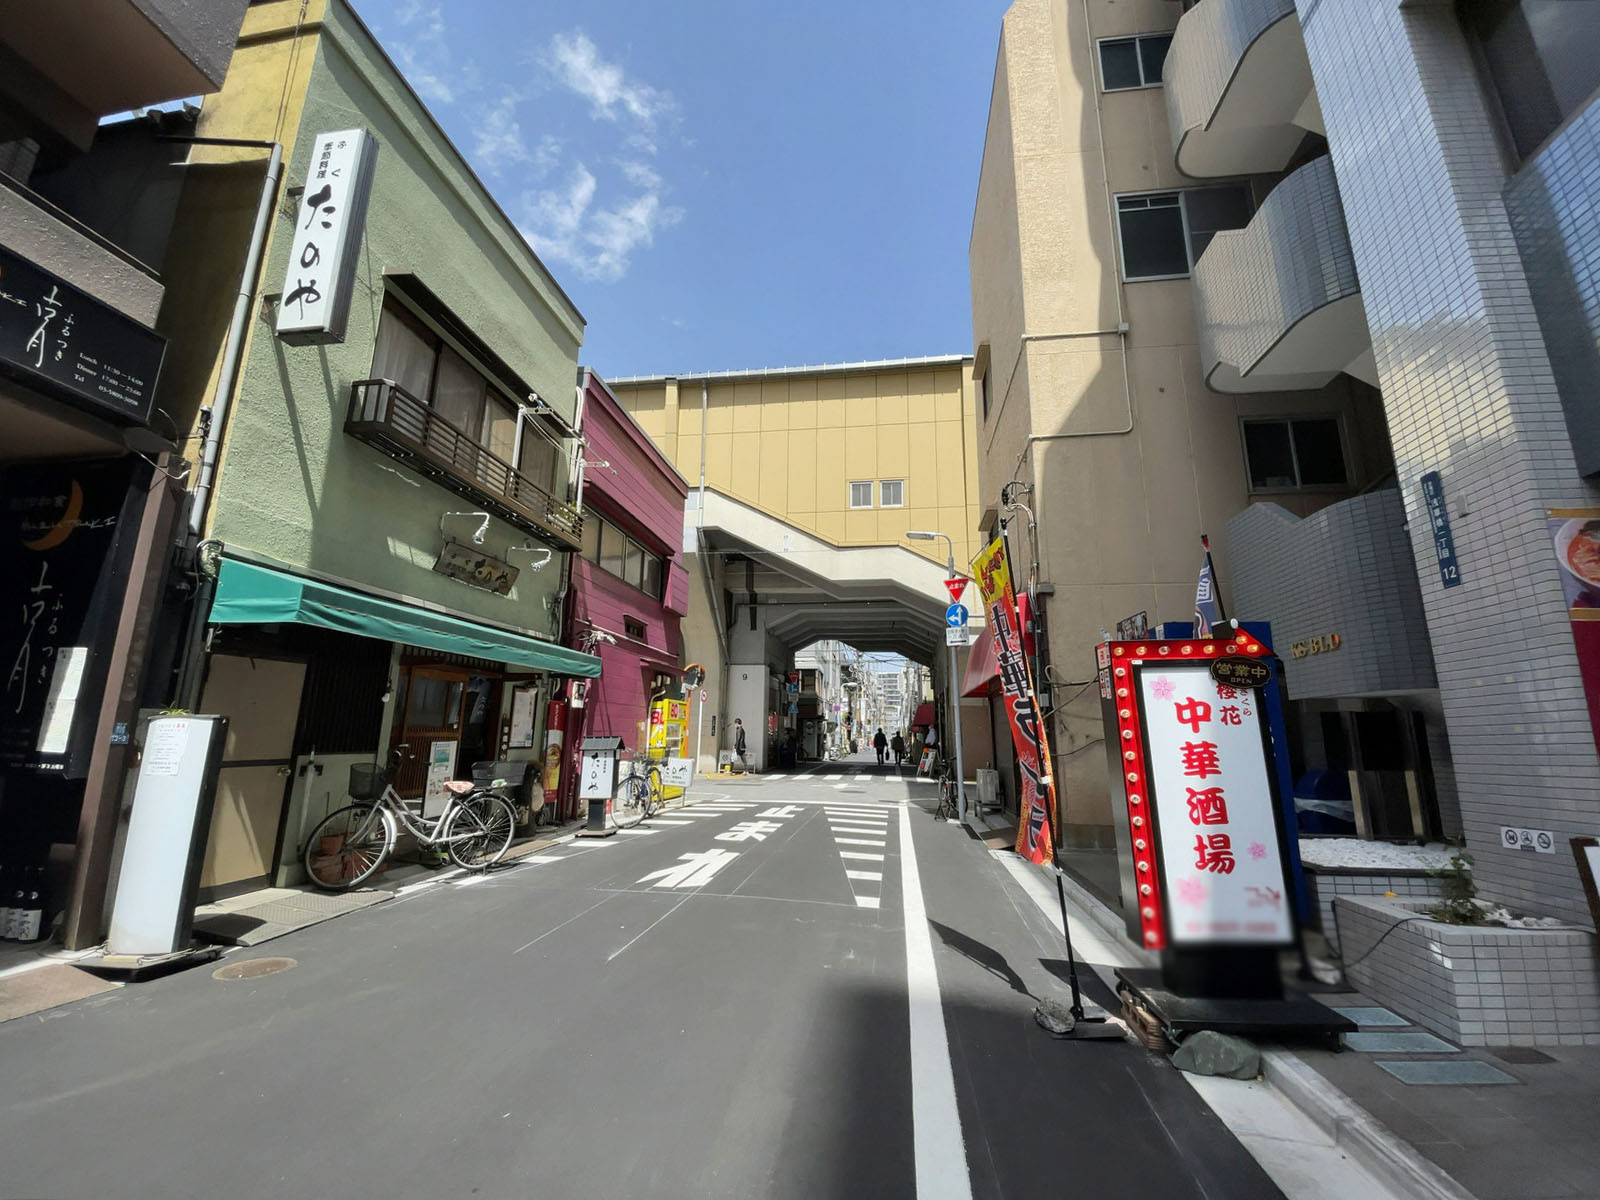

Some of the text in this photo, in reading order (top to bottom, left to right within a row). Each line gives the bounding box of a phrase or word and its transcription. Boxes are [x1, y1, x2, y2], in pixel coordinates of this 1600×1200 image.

[285, 184, 336, 320] たのや
[55, 314, 74, 361] ふるつき
[77, 363, 97, 376] Dinner
[80, 352, 97, 365] Lunch
[74, 373, 85, 382] Tel
[1443, 566, 1457, 579] 12
[37, 593, 64, 685] ふるつき
[742, 673, 748, 681] 9
[1216, 663, 1267, 678] 営業中
[587, 752, 600, 795] たのや
[1174, 696, 1236, 875] 中華酒場
[636, 805, 806, 889] 止まれ
